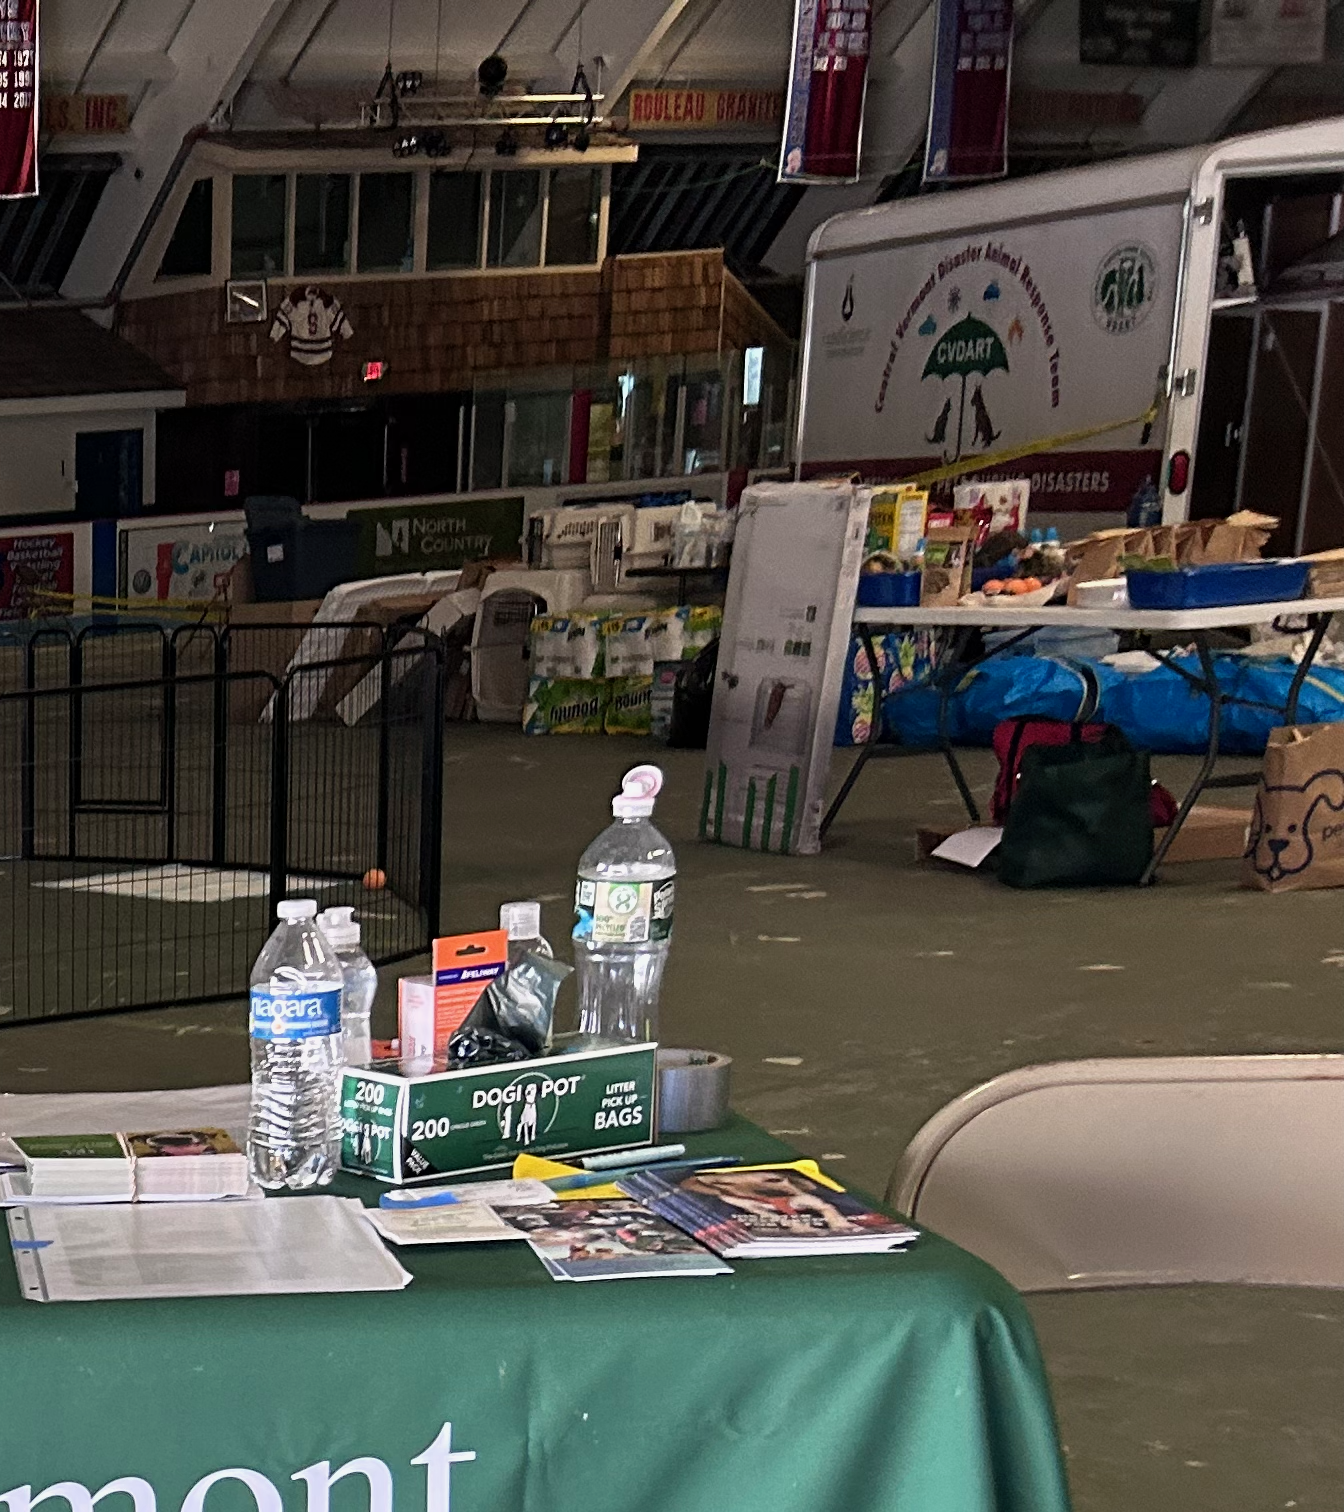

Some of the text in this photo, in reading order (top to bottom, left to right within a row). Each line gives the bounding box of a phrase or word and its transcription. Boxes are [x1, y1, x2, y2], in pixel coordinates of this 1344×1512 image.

[874, 340, 899, 413] Central
[896, 272, 937, 339] Vermont
[937, 246, 983, 281] Disaster
[984, 241, 1023, 277] Animal
[1019, 264, 1056, 347] Response
[1049, 348, 1061, 409] Team
[935, 336, 996, 366] CVDART
[1030, 471, 1111, 494] DISASTERS
[412, 519, 467, 536] NORTH
[13, 535, 57, 550] Hockey
[420, 534, 493, 555] COUNTRY
[250, 996, 323, 1021] niagara
[355, 1081, 385, 1105] 200
[472, 1076, 580, 1109] DOGI POT
[605, 1081, 636, 1095] LITTER
[601, 1094, 637, 1108] PICK UP
[411, 1117, 450, 1141] 200
[593, 1106, 643, 1130] BAGS
[369, 1124, 392, 1140] POT
